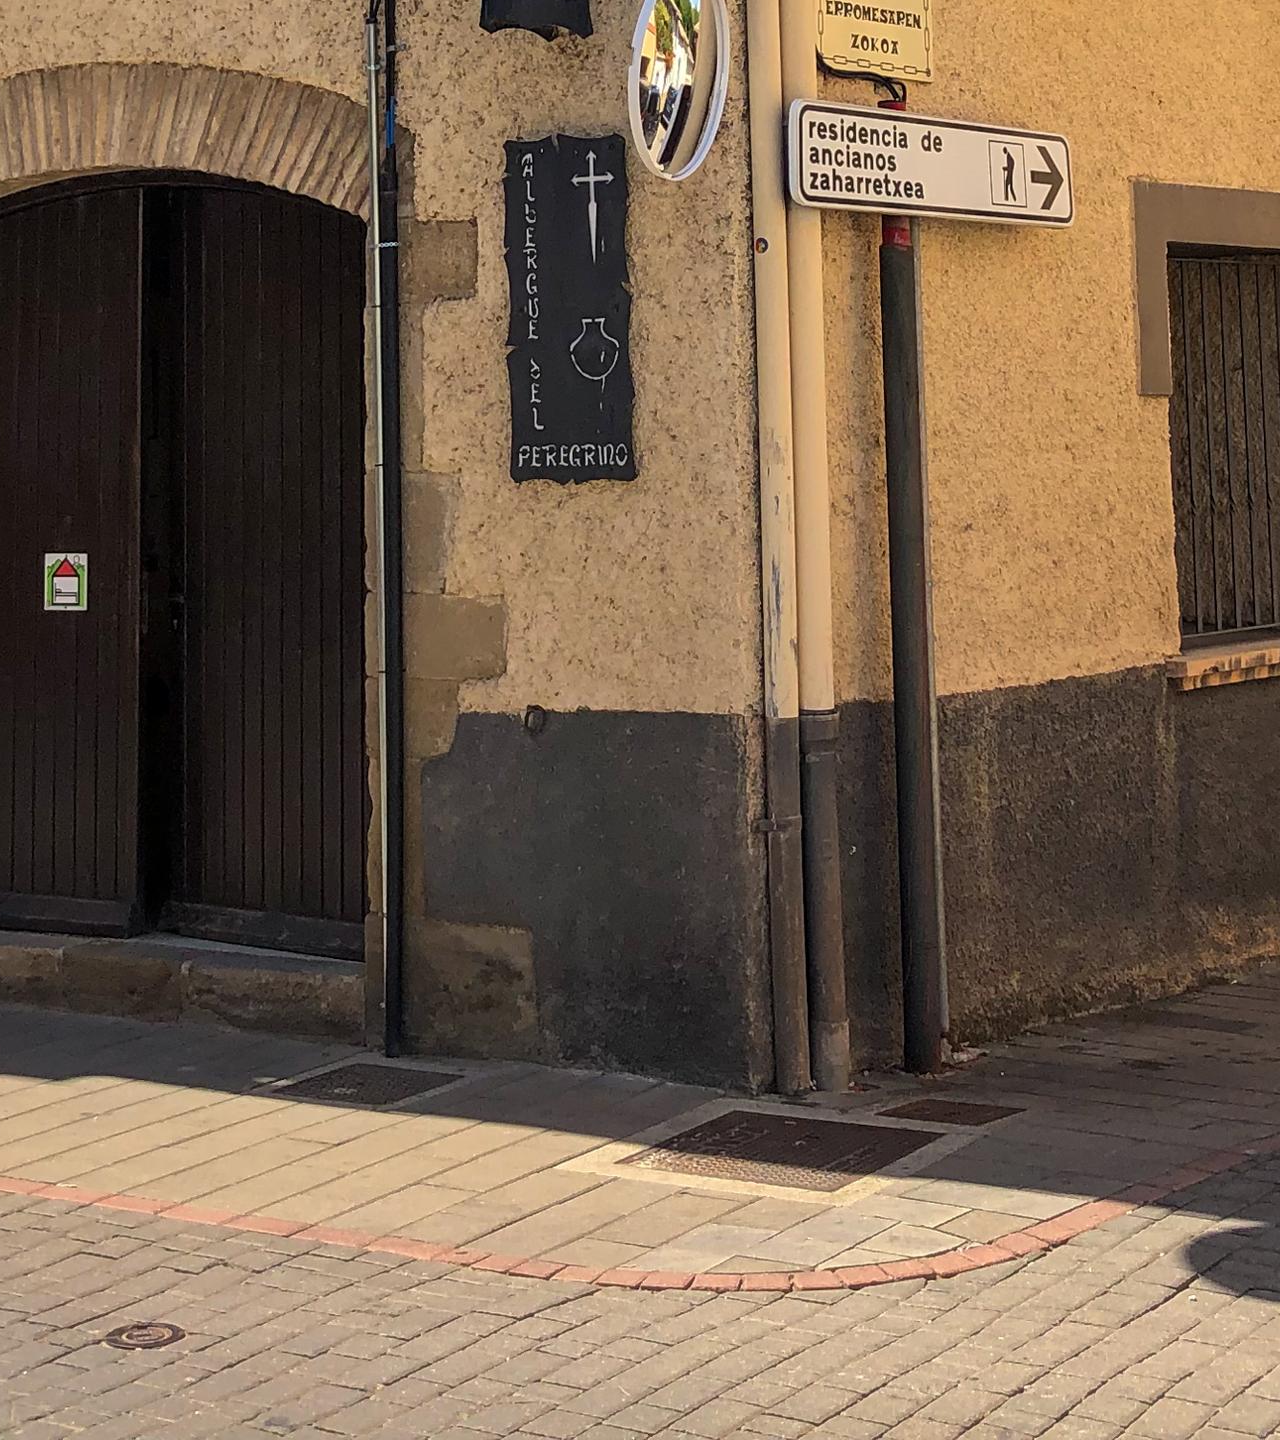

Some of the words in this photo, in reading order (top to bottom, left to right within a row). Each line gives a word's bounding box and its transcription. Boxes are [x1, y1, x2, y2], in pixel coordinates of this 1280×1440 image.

[825, 0, 922, 29] ERROMESAREN
[850, 33, 899, 55] ZOKOA
[809, 119, 909, 150] residencia
[920, 130, 943, 153] de
[809, 144, 897, 172] ancianos
[809, 169, 925, 199] zaharretxea
[521, 153, 540, 340] ALBERGUE
[529, 358, 545, 431] DEL
[517, 443, 629, 468] PEREGRINO
